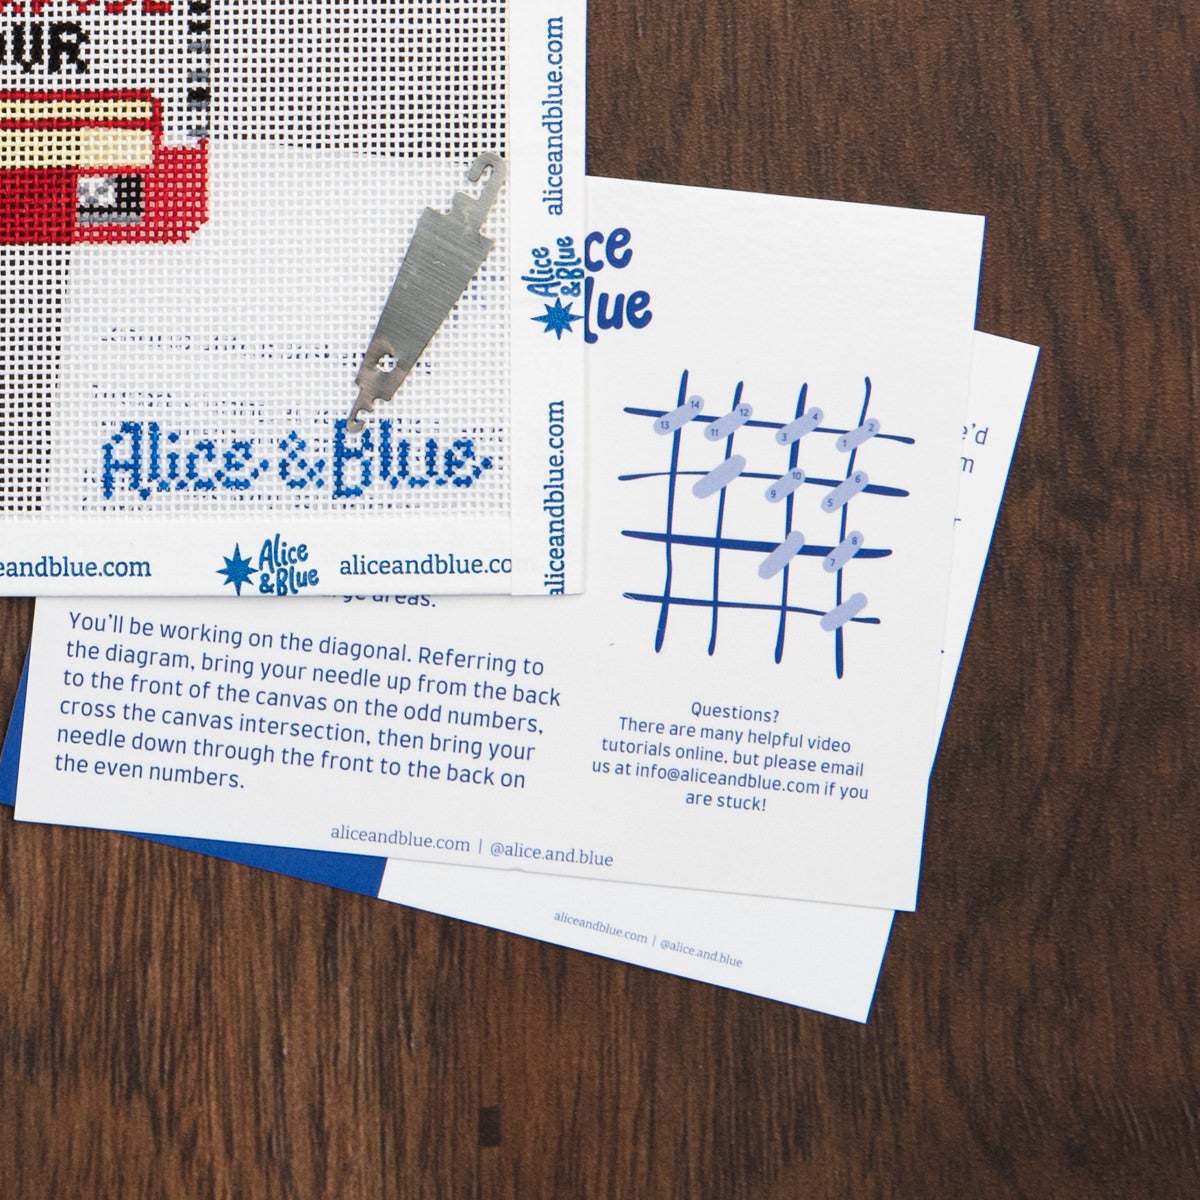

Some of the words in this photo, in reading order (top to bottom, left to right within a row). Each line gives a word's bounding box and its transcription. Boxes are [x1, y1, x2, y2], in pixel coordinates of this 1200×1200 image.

[542, 15, 564, 216] aliceandblue.com
[521, 246, 557, 298] Alice
[103, 421, 270, 500] Alice
[278, 430, 325, 489] &
[332, 419, 493, 499] Blue
[258, 533, 309, 573] Alice
[129, 616, 154, 637] be
[159, 623, 243, 649] working
[248, 632, 273, 649] on
[279, 632, 313, 653] the
[318, 636, 412, 663] diagonal.
[418, 646, 517, 677] Referring
[523, 658, 544, 676] to
[66, 639, 100, 660] the
[105, 643, 195, 671] diagram,
[201, 652, 254, 680] bring
[260, 662, 307, 681] your
[312, 667, 381, 688] needle
[387, 675, 412, 695] up
[418, 673, 467, 697] from
[473, 680, 507, 701] the
[512, 683, 561, 707] back
[63, 669, 85, 688] to
[91, 671, 125, 691] the
[130, 673, 183, 697] front
[188, 681, 212, 699] of
[216, 683, 250, 704] the
[255, 690, 327, 711] canvas
[333, 698, 358, 715] on
[364, 698, 398, 719] the
[403, 703, 442, 723] odd
[447, 710, 543, 735] numbers,
[690, 701, 780, 724] Questions?
[59, 699, 116, 719] cross
[122, 702, 156, 723] the
[161, 709, 233, 731] canvas
[239, 713, 371, 746] intersection,
[378, 728, 424, 750] then
[429, 732, 483, 760] bring
[488, 742, 536, 761] your
[619, 716, 665, 735] There
[668, 723, 696, 738] are
[700, 727, 744, 745] many
[747, 728, 804, 749] helpful
[807, 735, 851, 754] video
[55, 753, 89, 774] the
[94, 760, 143, 779] even
[149, 765, 244, 789] numbers.
[57, 728, 126, 749] needle
[131, 732, 187, 755] down
[193, 738, 275, 766] through
[281, 747, 315, 767] the
[321, 749, 374, 773] front
[380, 757, 401, 776] to
[407, 759, 441, 780] the
[446, 763, 495, 786] back
[500, 772, 525, 789] on
[592, 761, 611, 774] us
[614, 762, 632, 776] at
[635, 762, 820, 795] info@aliceandblue.com
[824, 781, 836, 796] if
[839, 786, 869, 801] you
[601, 738, 671, 758] tutorials
[675, 745, 728, 764] online,
[732, 749, 760, 767] but
[763, 753, 817, 772] please
[820, 761, 864, 777] email
[685, 792, 713, 807] are
[716, 794, 767, 812] stuck!
[330, 824, 470, 852] aliceandblue.com
[490, 841, 614, 867] @alice.and.blue
[553, 911, 648, 944] aliceandblue.com
[659, 939, 743, 968] @alice.and.blue
